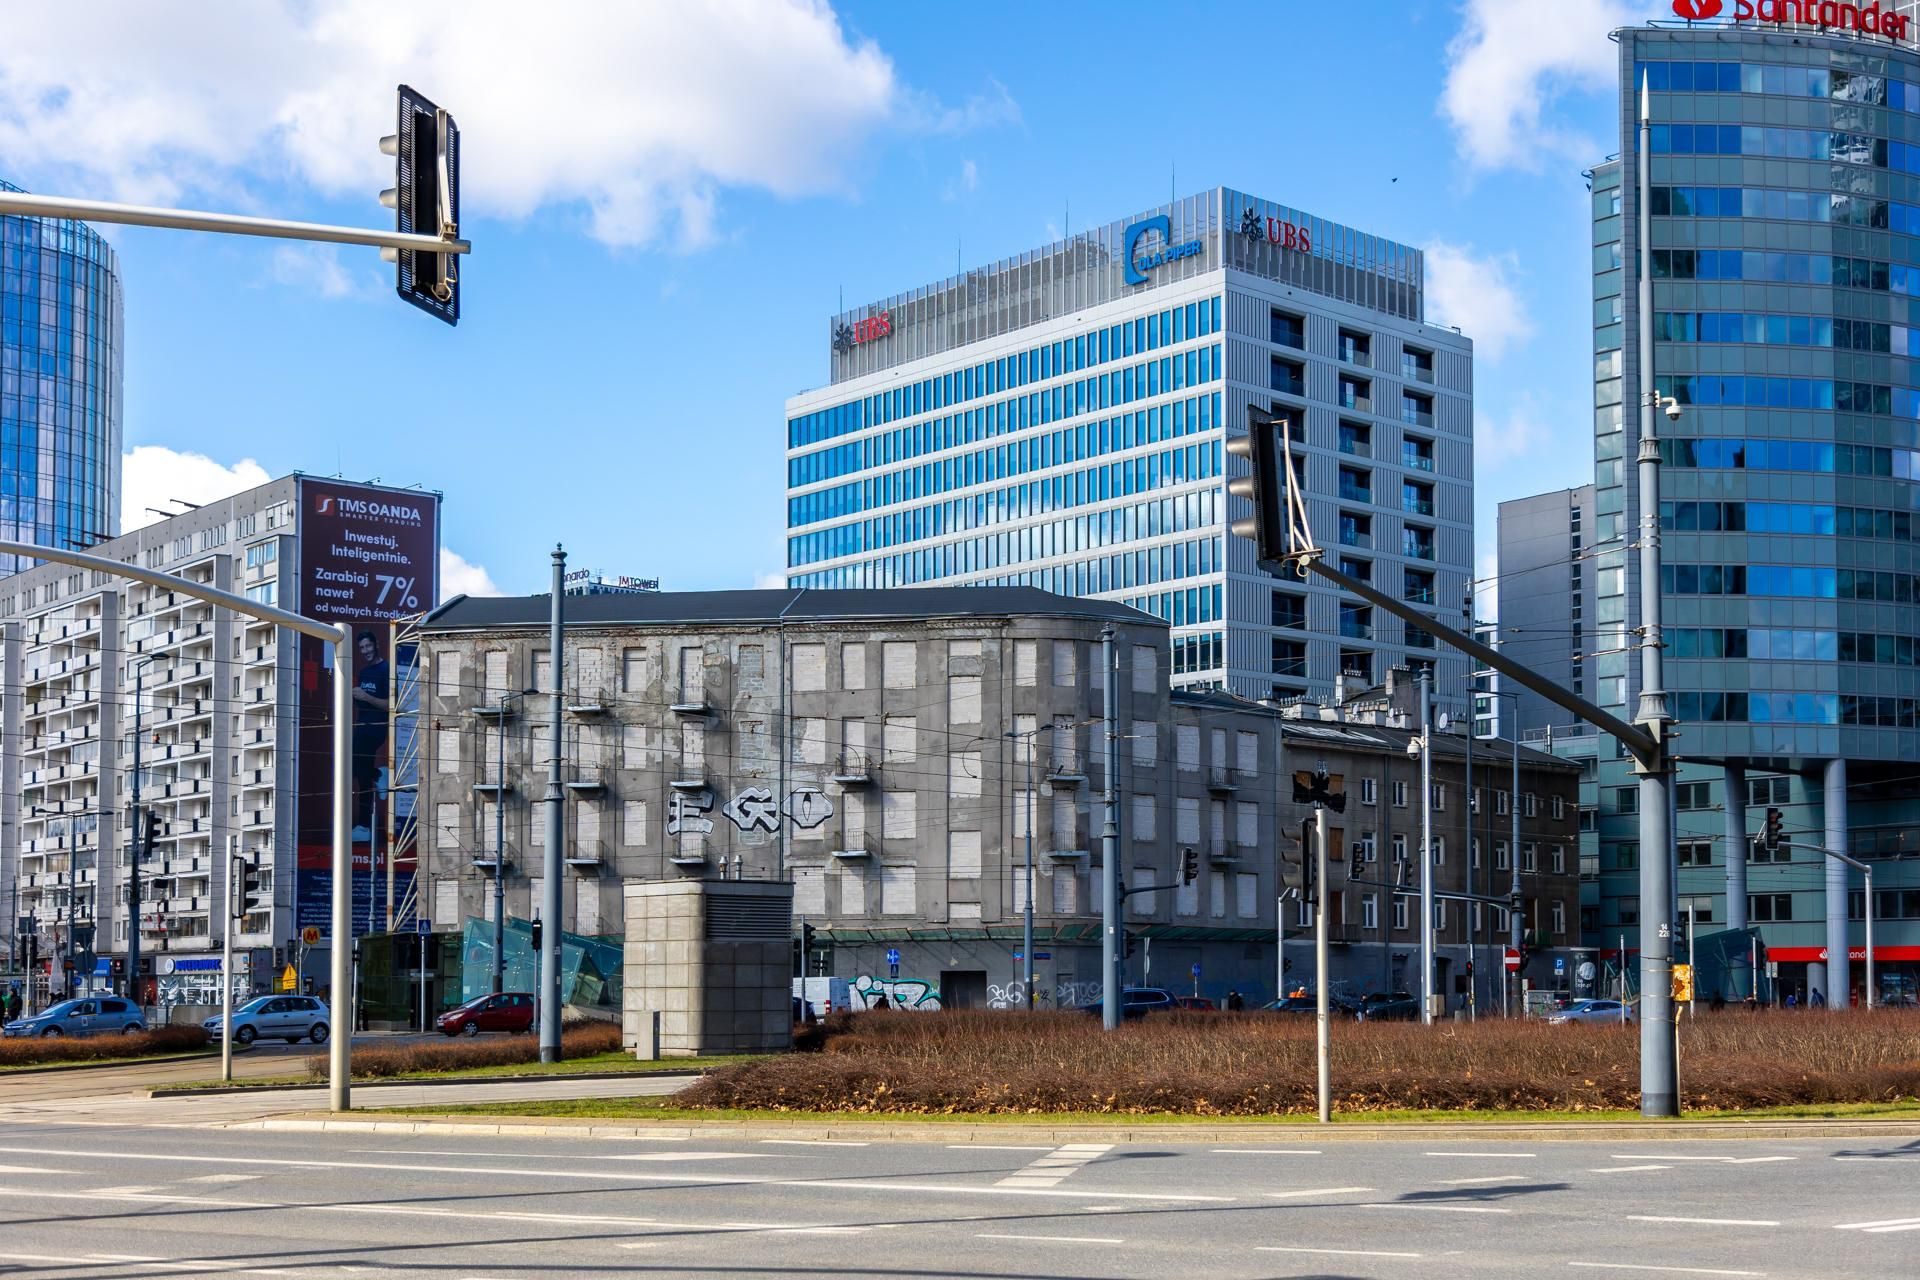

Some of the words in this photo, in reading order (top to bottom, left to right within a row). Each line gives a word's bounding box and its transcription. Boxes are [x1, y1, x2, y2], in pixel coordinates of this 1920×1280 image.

[1733, 0, 1911, 40] Santander
[1266, 217, 1311, 253] UBS
[1138, 255, 1162, 271] DLA
[1164, 240, 1201, 263] PIPER
[854, 310, 892, 344] UBS
[337, 498, 367, 513] TMS
[369, 502, 421, 521] OANDA
[345, 529, 399, 550] Inwestuj.
[332, 544, 412, 565] Inteligentnie.
[315, 567, 369, 588] Zarabiaj
[315, 587, 355, 600] nawet
[375, 574, 418, 609] 7%
[315, 603, 329, 613] od
[331, 604, 372, 619] wolnych
